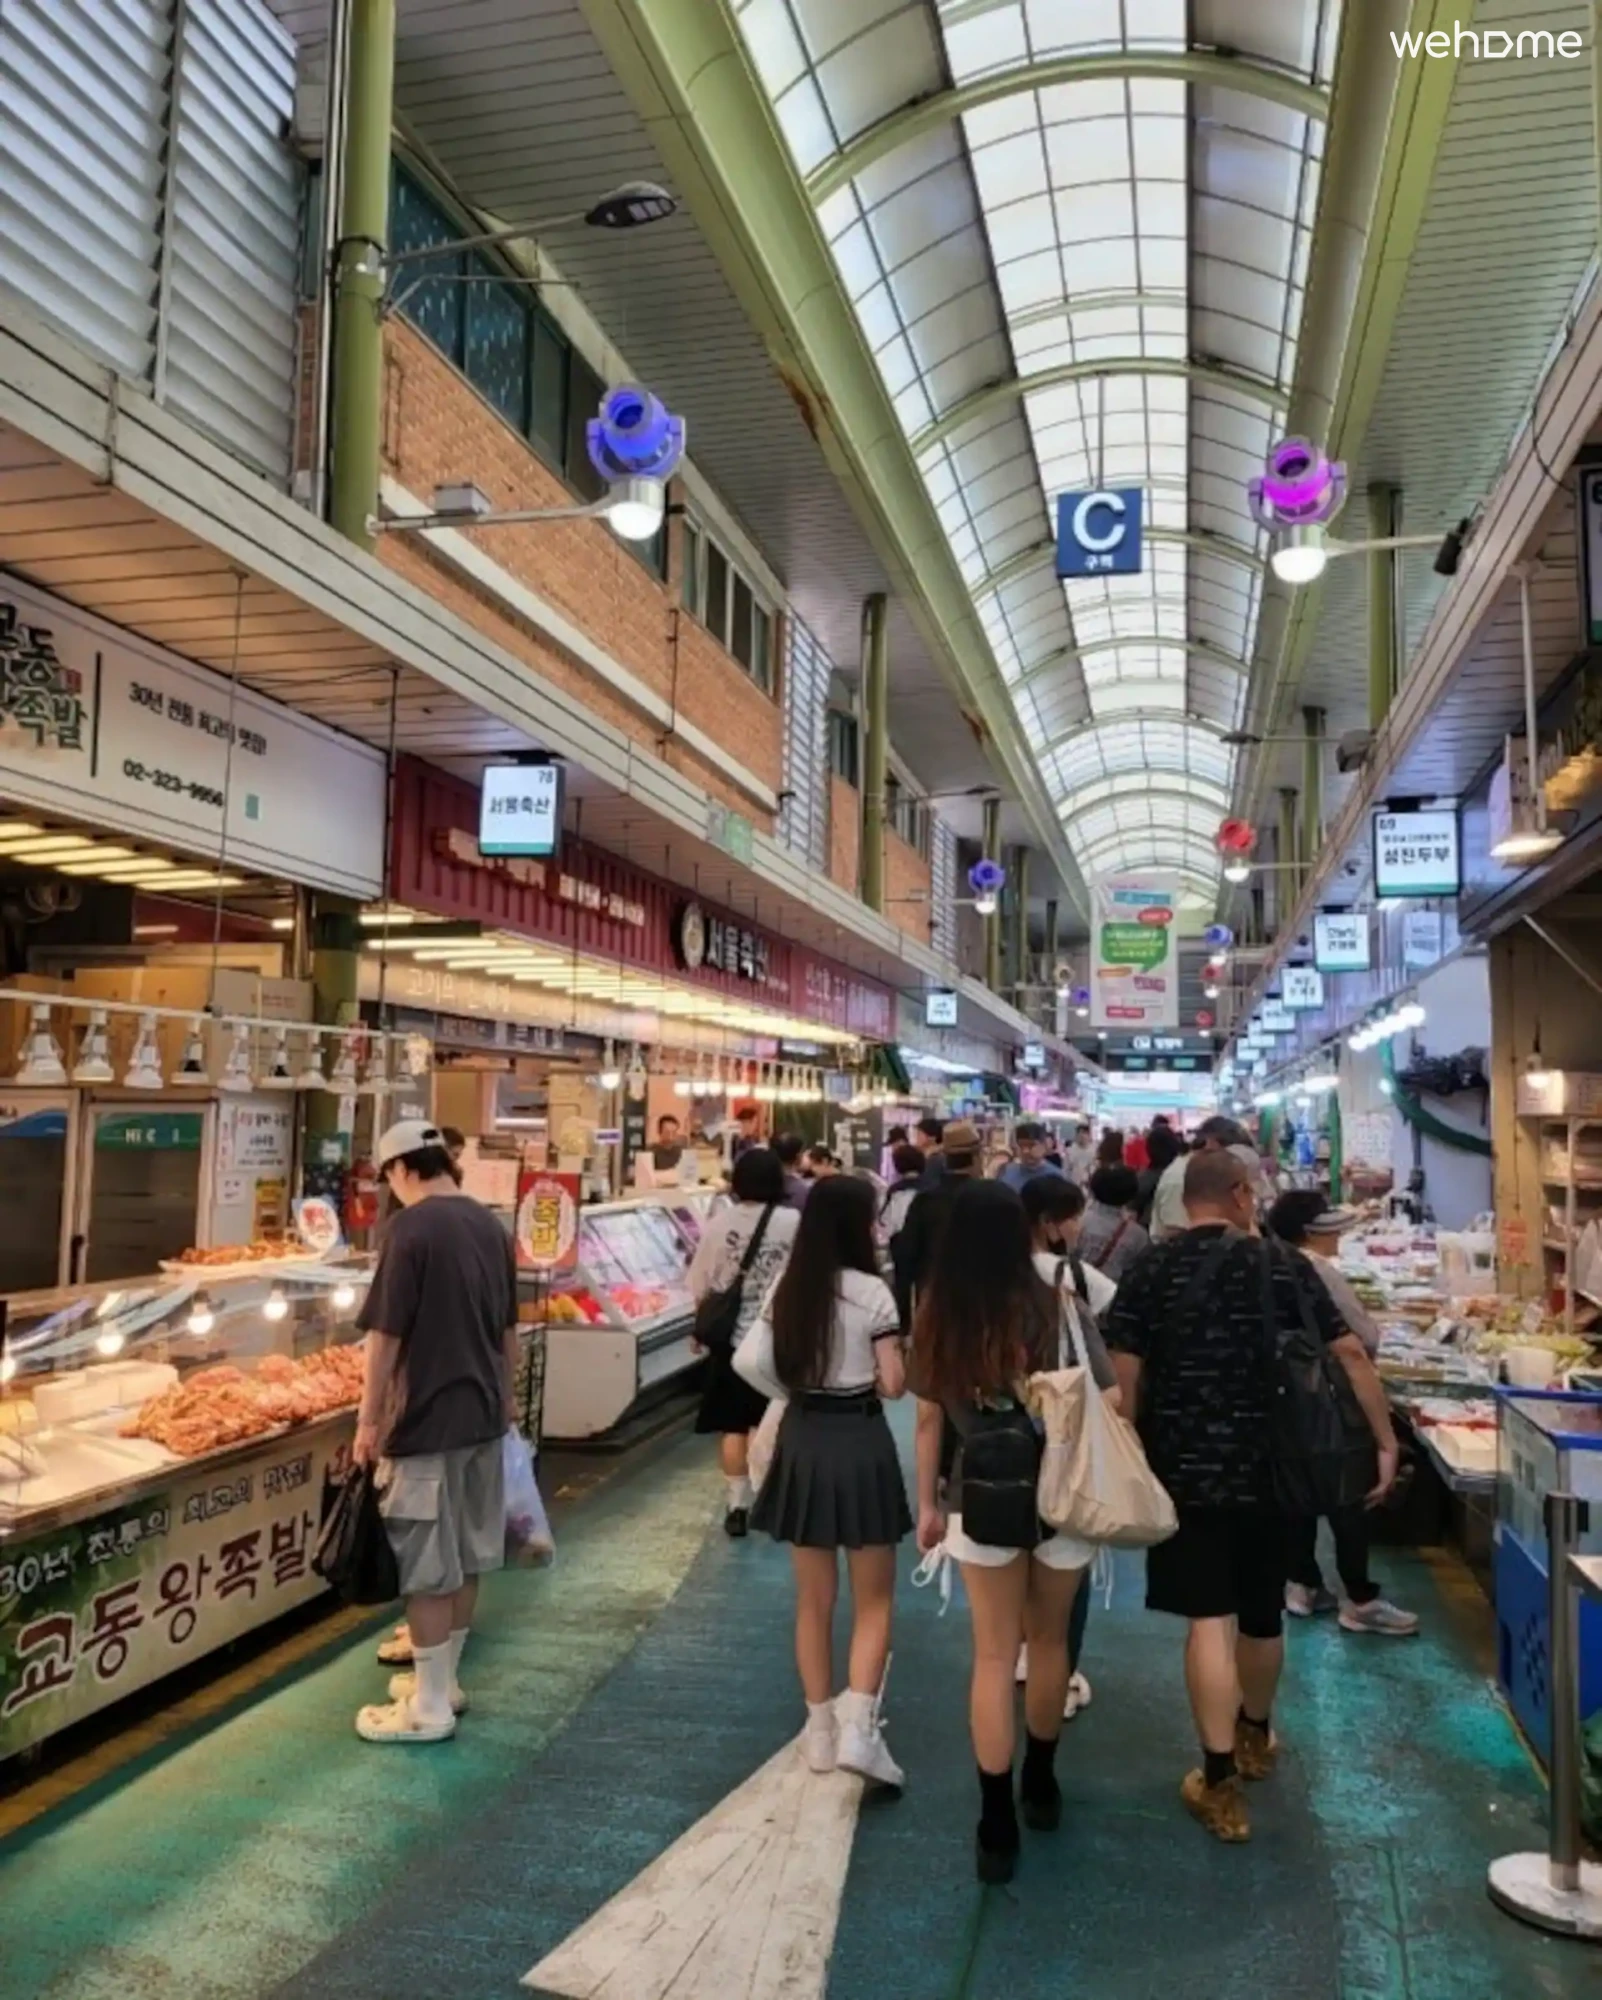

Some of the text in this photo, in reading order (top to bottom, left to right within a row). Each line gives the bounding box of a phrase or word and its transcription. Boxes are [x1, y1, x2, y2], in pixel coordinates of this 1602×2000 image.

[1073, 492, 1126, 552] C
[0, 1543, 72, 1602] 30년
[86, 1506, 172, 1565] 전통의
[2, 1508, 315, 1718] 교동왕족발
